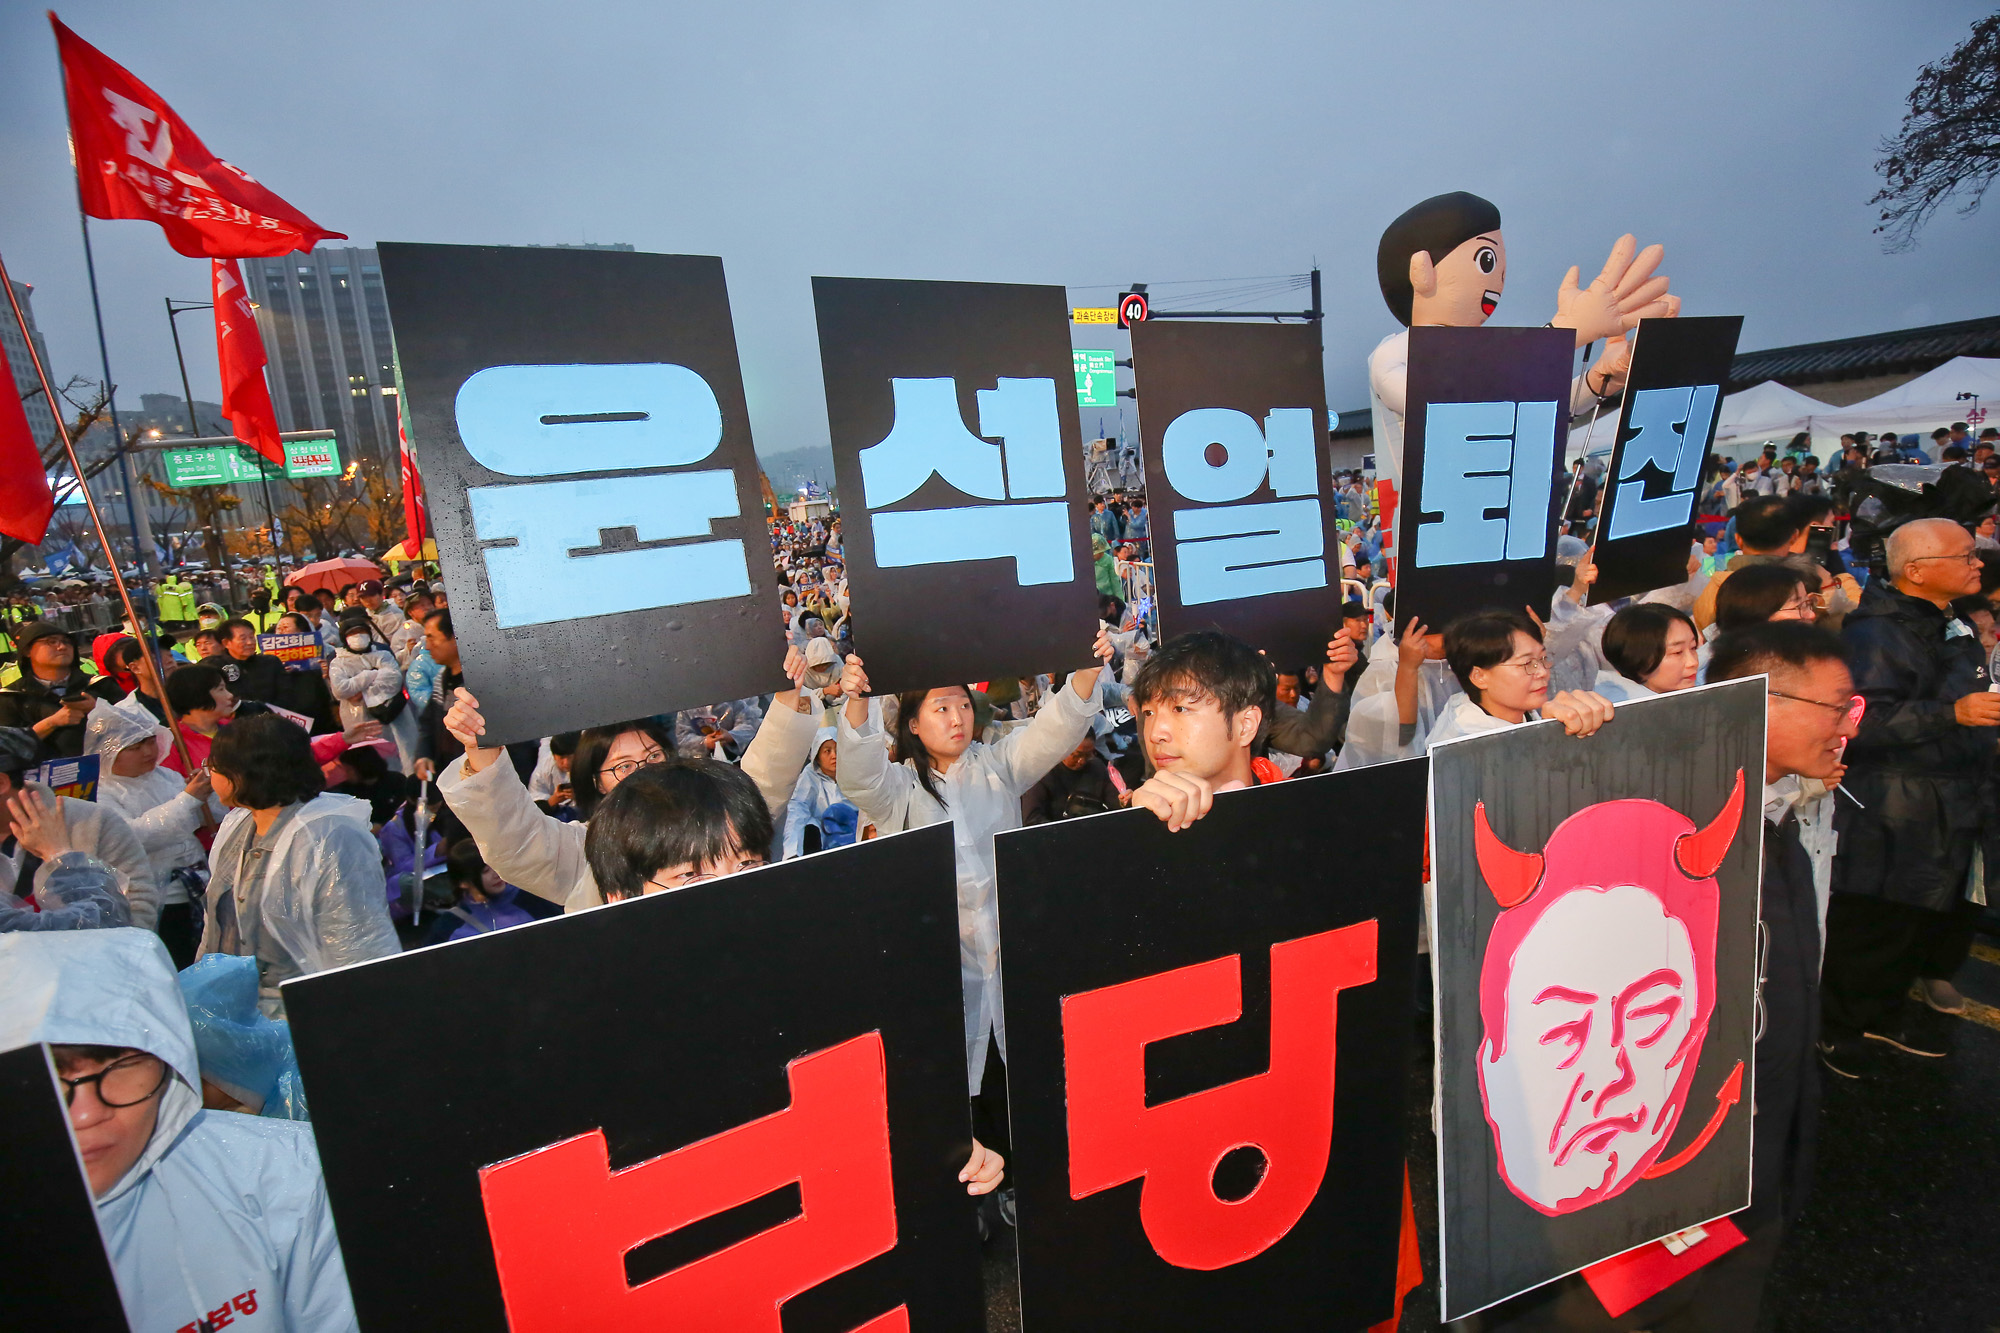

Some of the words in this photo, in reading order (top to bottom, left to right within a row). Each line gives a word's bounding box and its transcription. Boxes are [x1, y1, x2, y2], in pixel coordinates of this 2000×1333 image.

[1076, 310, 1116, 322] 과속단속장비
[1126, 303, 1142, 319] 40
[290, 445, 329, 454] 삼청터널
[173, 452, 216, 464] 종로구청
[1608, 384, 1719, 541] 진
[859, 377, 1074, 587] 석
[454, 362, 751, 629] 윤
[360, 582, 368, 591] K
[262, 634, 315, 650] 김건희를
[263, 645, 323, 662] 검하라!
[1061, 918, 1379, 1271] 당
